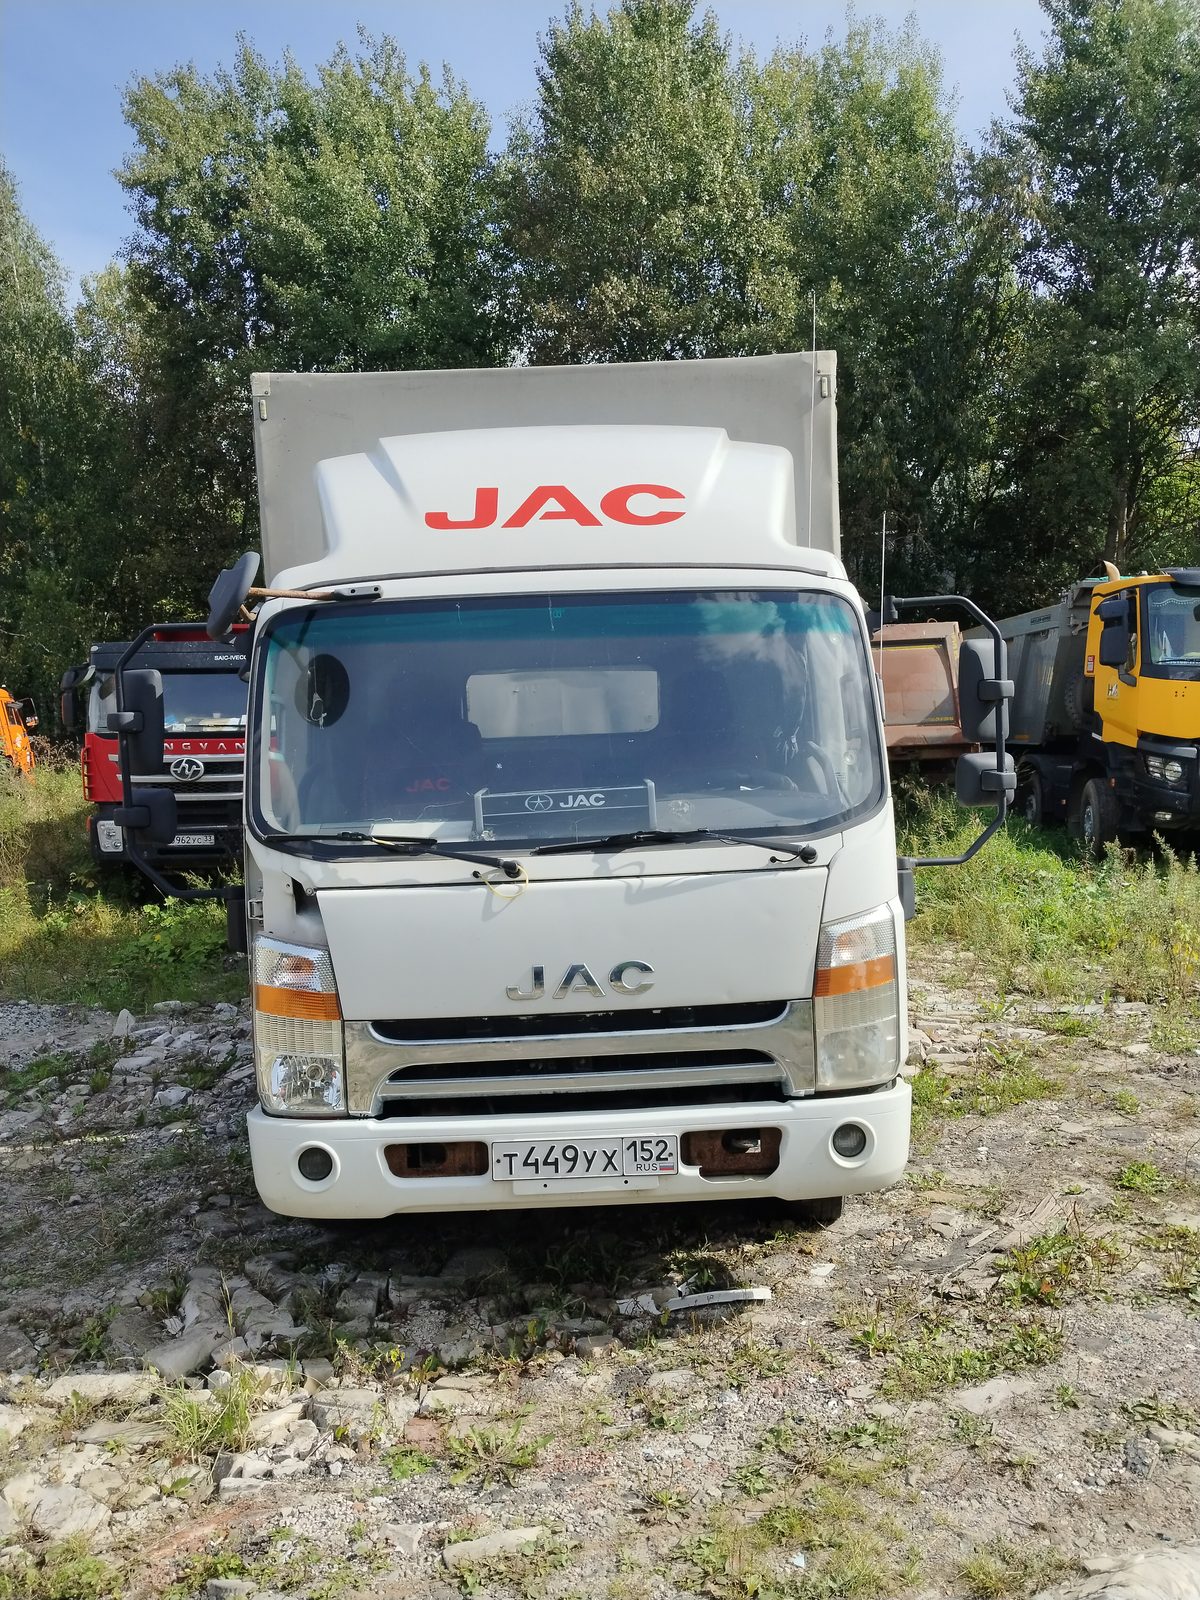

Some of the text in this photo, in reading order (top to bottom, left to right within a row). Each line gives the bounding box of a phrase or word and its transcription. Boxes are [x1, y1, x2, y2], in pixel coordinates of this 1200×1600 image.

[425, 484, 687, 530] JAC
[406, 778, 450, 792] JAC
[559, 793, 606, 808] JAC
[172, 836, 202, 844] 962УС
[506, 960, 655, 1000] JAC
[503, 1139, 669, 1175] Т449УХ 152
[636, 1163, 658, 1172] RUS
